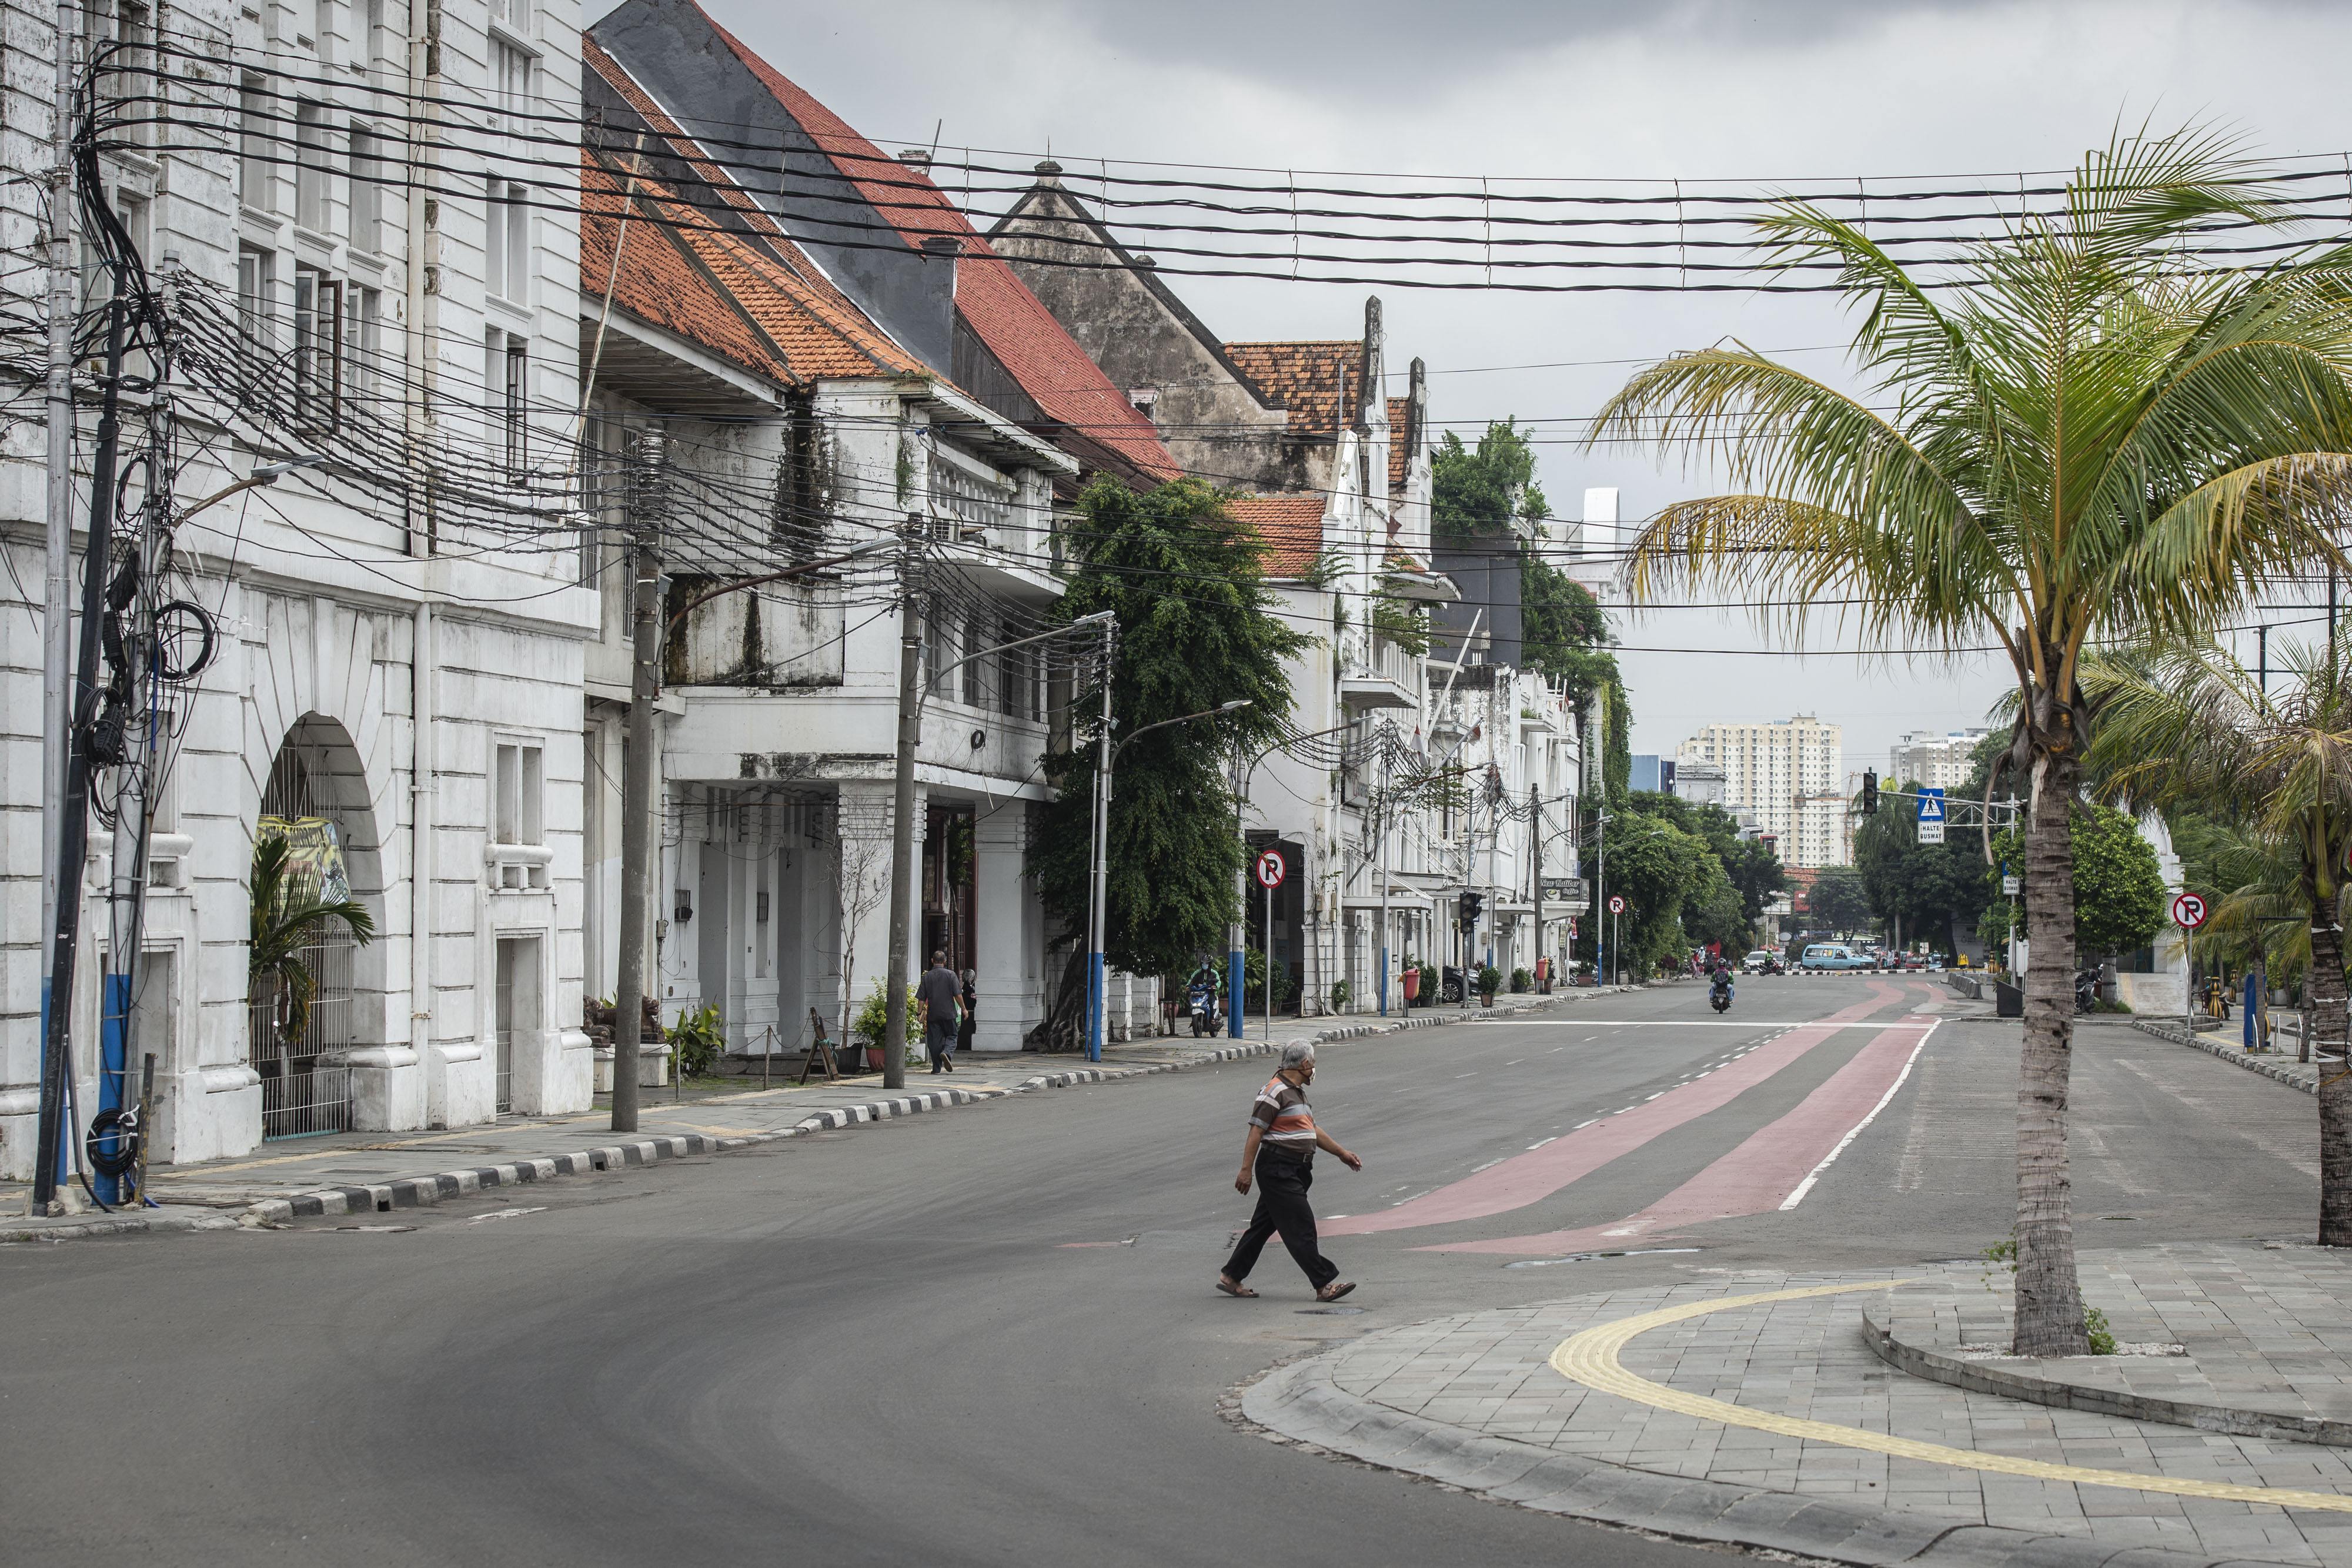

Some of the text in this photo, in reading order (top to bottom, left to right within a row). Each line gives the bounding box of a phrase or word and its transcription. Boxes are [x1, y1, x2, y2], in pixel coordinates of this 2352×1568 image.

[1265, 859, 1278, 880] P
[1613, 900, 1621, 910] P
[2185, 901, 2200, 921] P
